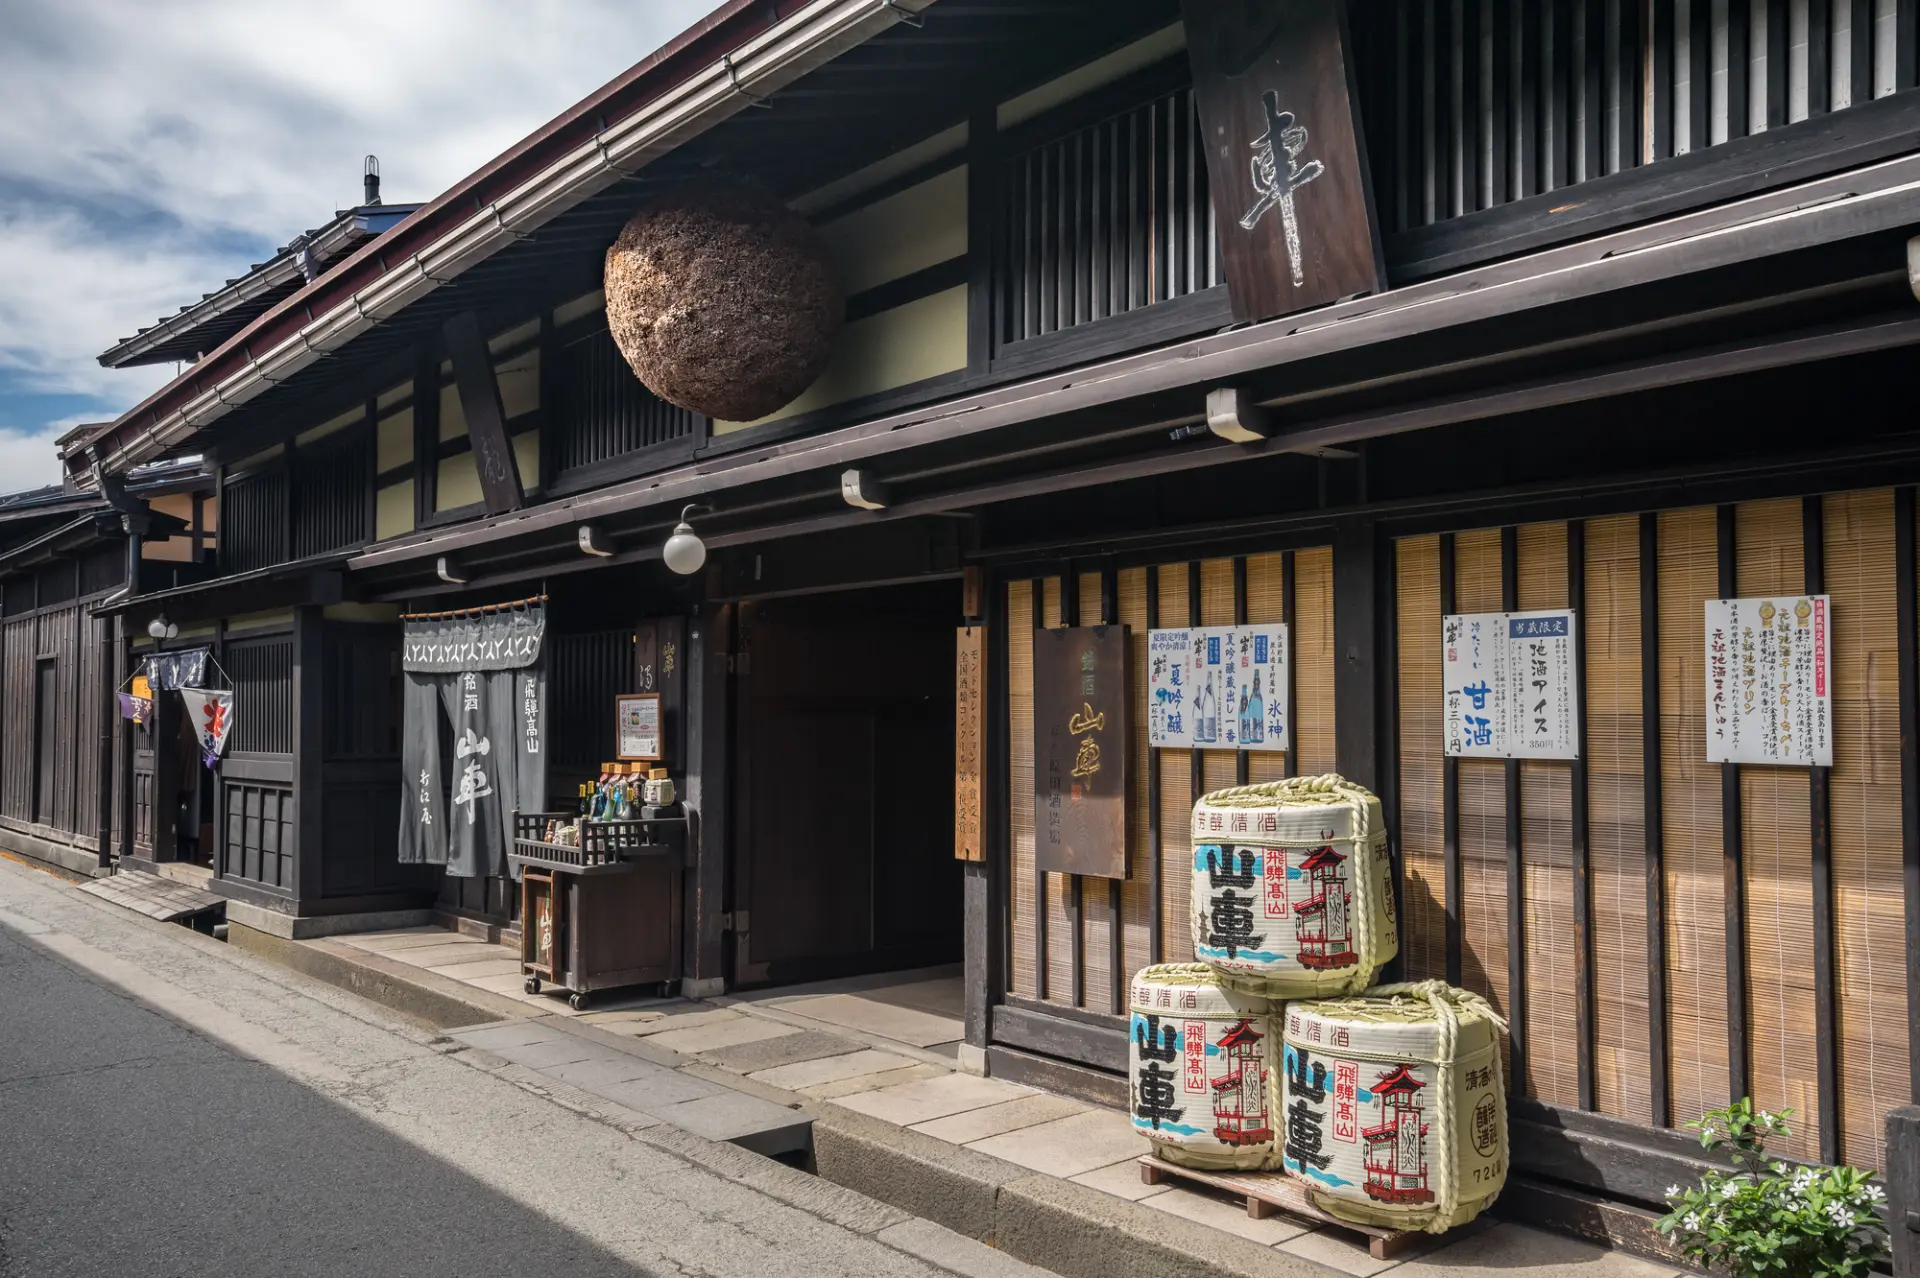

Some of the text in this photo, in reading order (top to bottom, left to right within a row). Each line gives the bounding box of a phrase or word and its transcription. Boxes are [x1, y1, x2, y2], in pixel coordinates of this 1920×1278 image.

[1194, 637, 1203, 657] 山車
[1240, 635, 1249, 655] 山車
[1446, 623, 1458, 647] 山車
[1515, 620, 1565, 635] 当蔵限定
[463, 672, 478, 712] 銘酒
[1153, 656, 1164, 678] 山車
[1167, 663, 1184, 734] 夏吟醸
[1225, 632, 1237, 743] 夏吟醸蔵出し一番
[1529, 639, 1549, 735] 地酒アイス
[1711, 628, 1727, 740] 元祖地酒まんじゅう
[1742, 627, 1756, 715] 元祖地酒プリン
[1778, 608, 1793, 757] 元祖地酒チーズケーキバー
[1068, 701, 1105, 793] 山車
[1267, 699, 1283, 740] 氷神
[1463, 679, 1493, 747] 甘酒
[1529, 740, 1554, 749] 350円
[1817, 699, 1826, 749] ※試食あります
[453, 727, 494, 825] 山車
[540, 907, 553, 960] 山車
[1207, 844, 1267, 960] 山車
[1136, 1014, 1187, 1131] 山車
[1286, 1047, 1335, 1175] 山車
